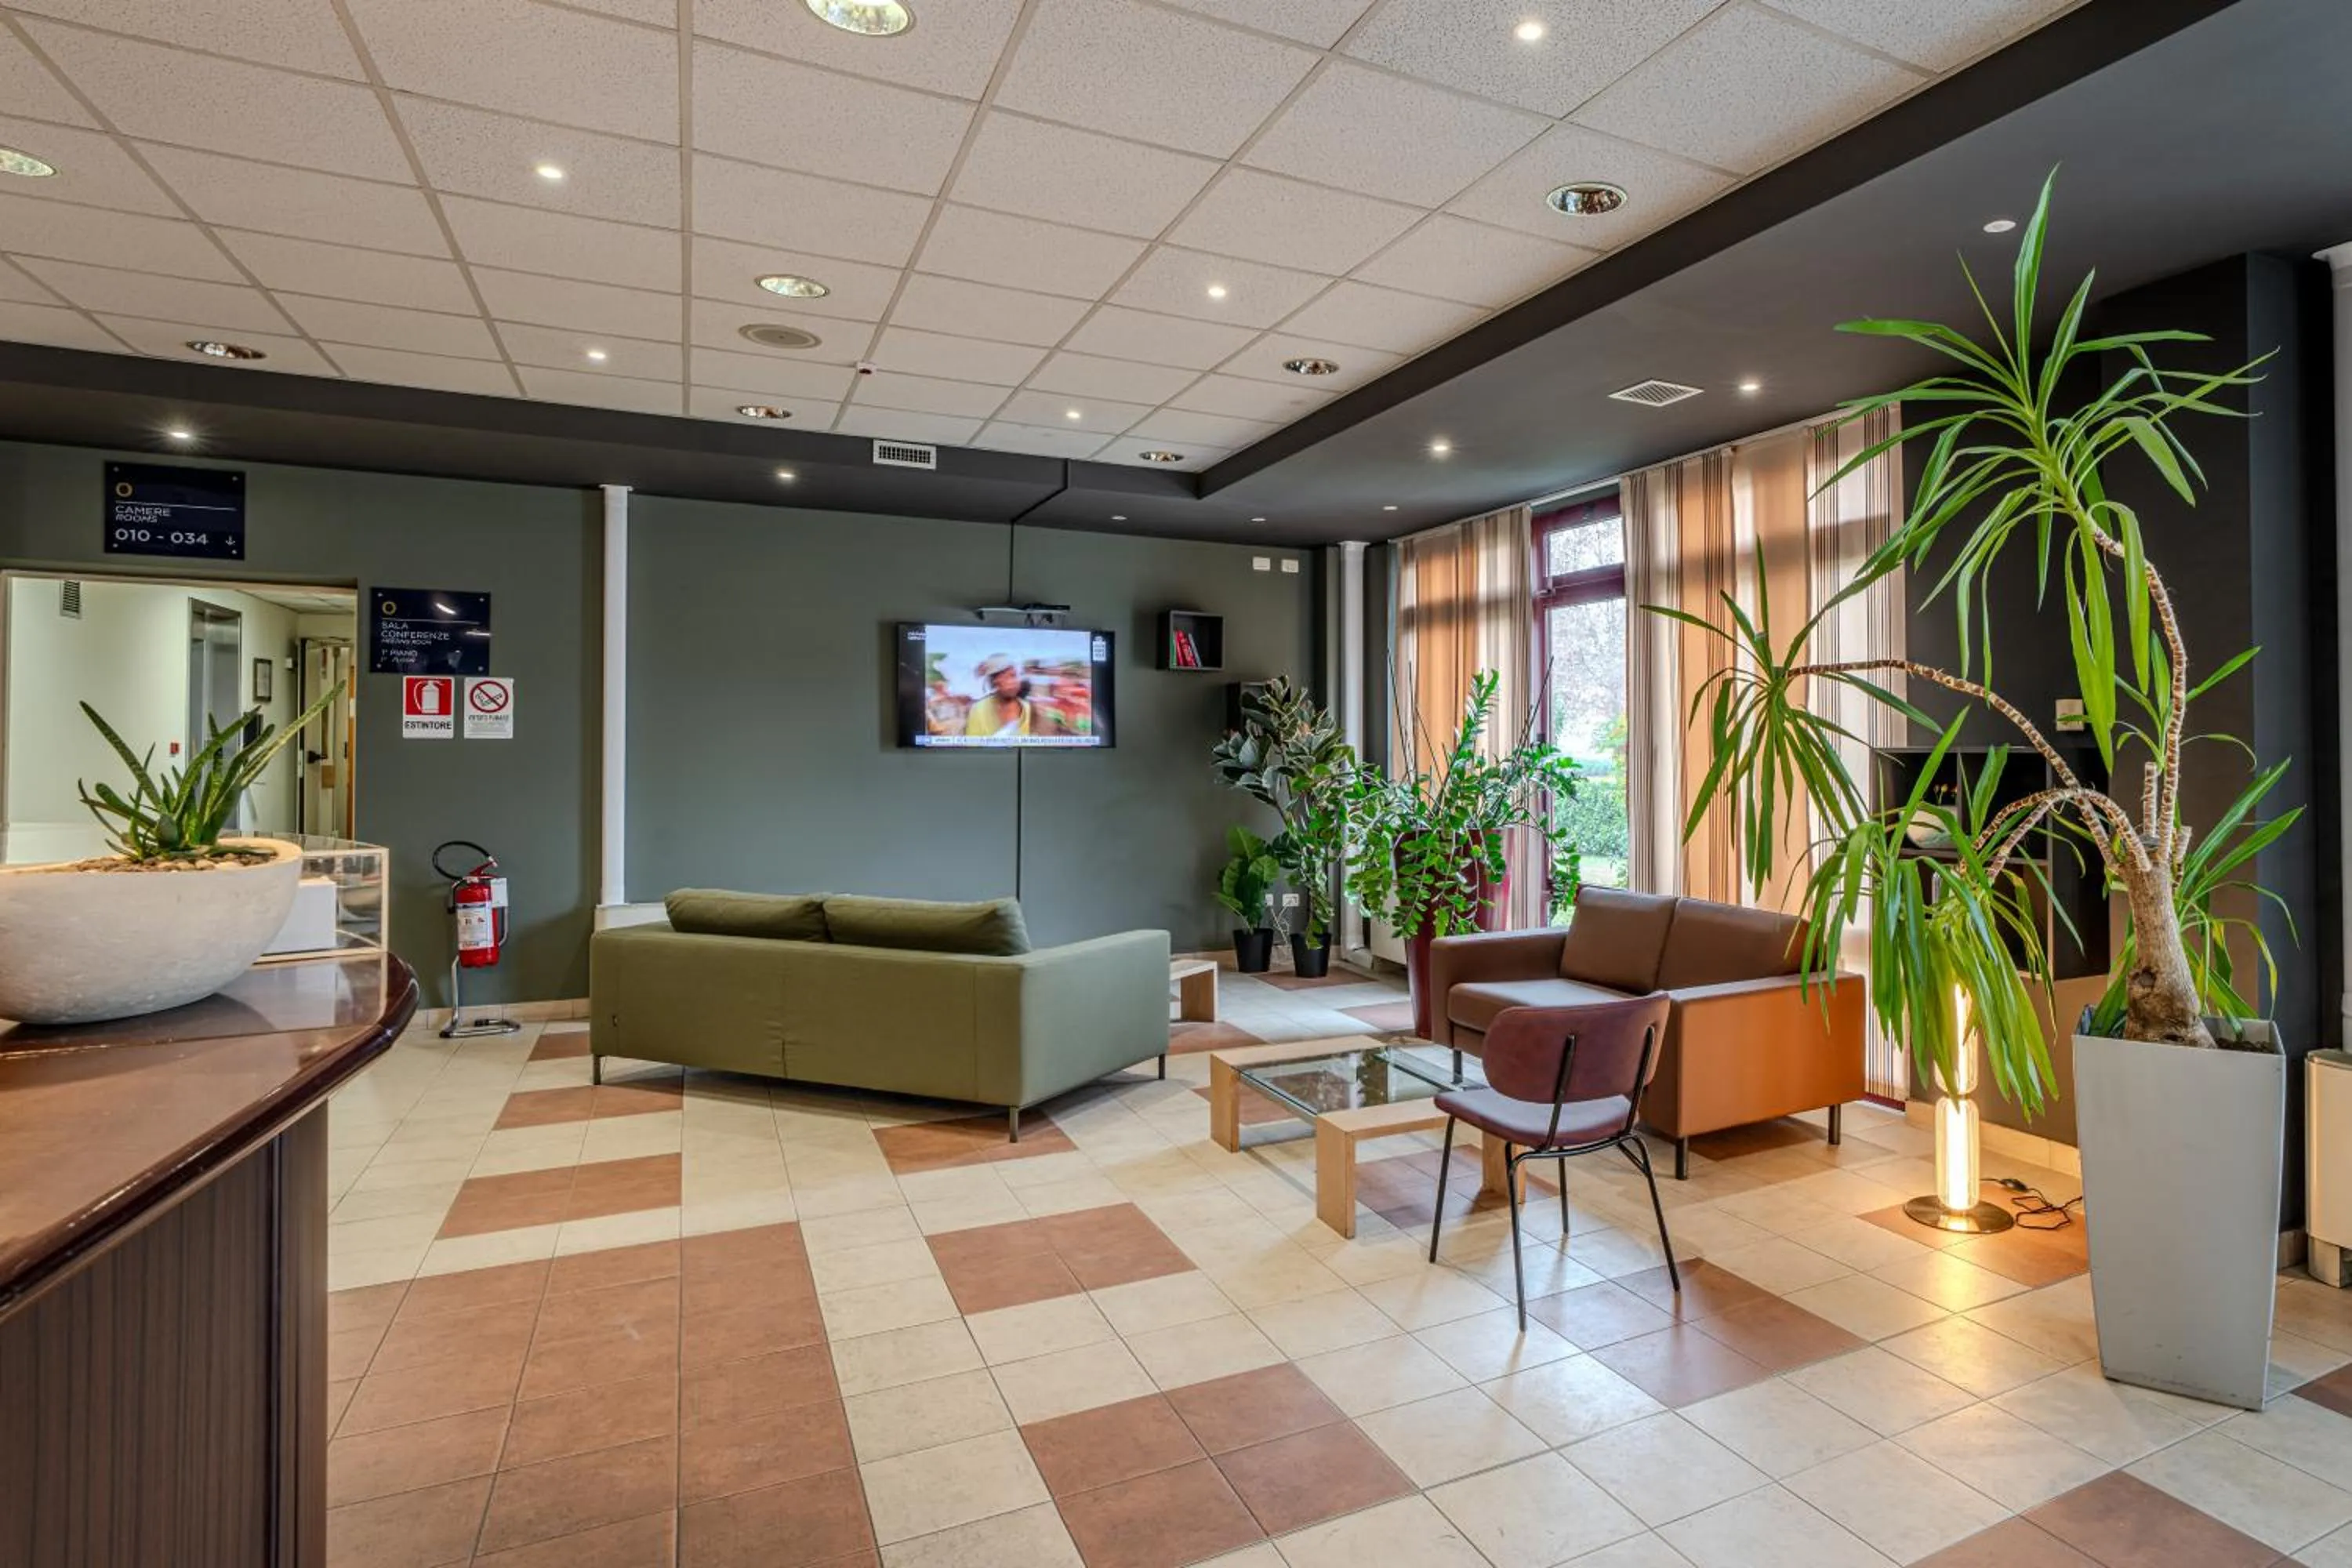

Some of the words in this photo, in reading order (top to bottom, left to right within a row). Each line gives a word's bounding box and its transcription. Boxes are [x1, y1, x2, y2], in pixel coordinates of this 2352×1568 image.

[115, 505, 172, 517] CAMERE
[115, 514, 158, 523] ROOMS
[115, 528, 151, 542] 010
[170, 532, 209, 545] 034
[382, 621, 408, 630] SALA
[381, 630, 450, 641] CONFERENZE
[404, 720, 452, 730] ESTINTORE
